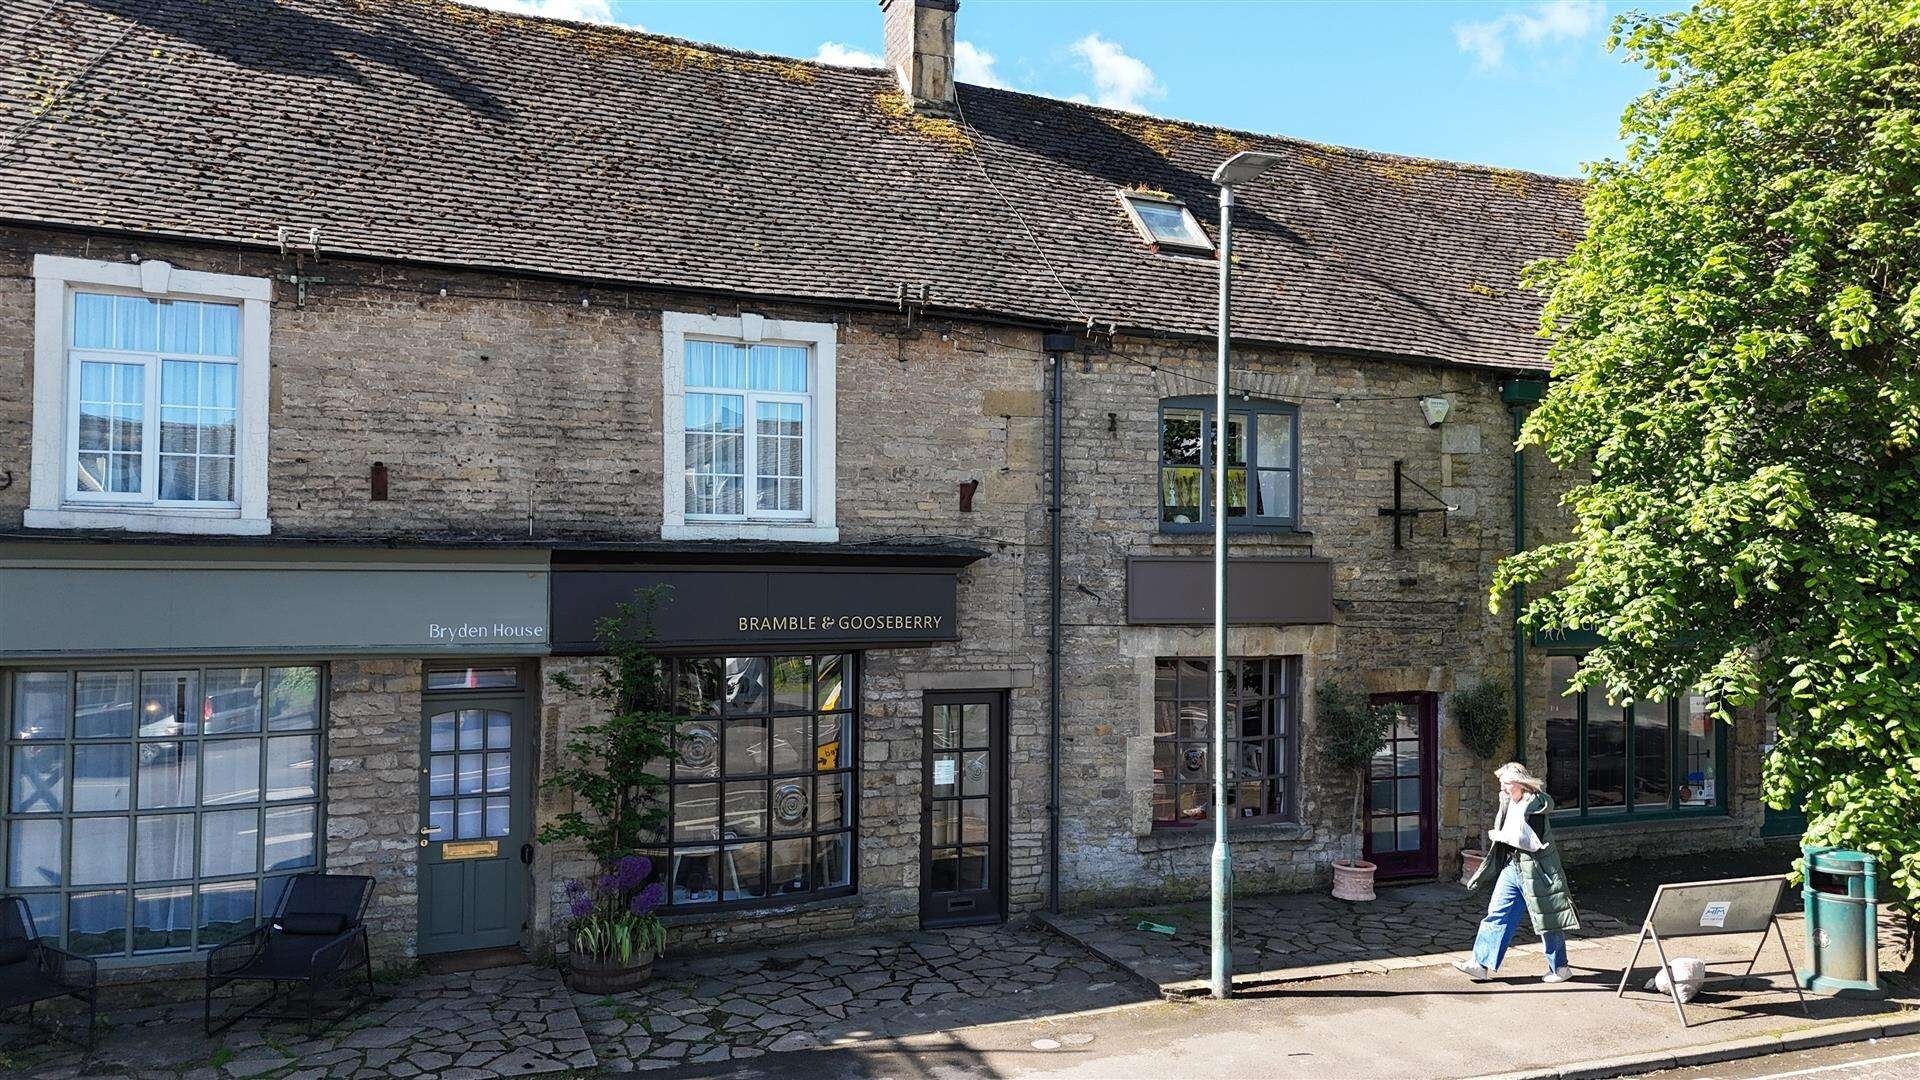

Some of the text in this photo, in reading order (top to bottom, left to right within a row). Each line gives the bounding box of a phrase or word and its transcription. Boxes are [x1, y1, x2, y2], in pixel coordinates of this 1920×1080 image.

[738, 615, 943, 631] BRAMBLE & GOOSEBERRY
[429, 623, 543, 641] Bryden House
